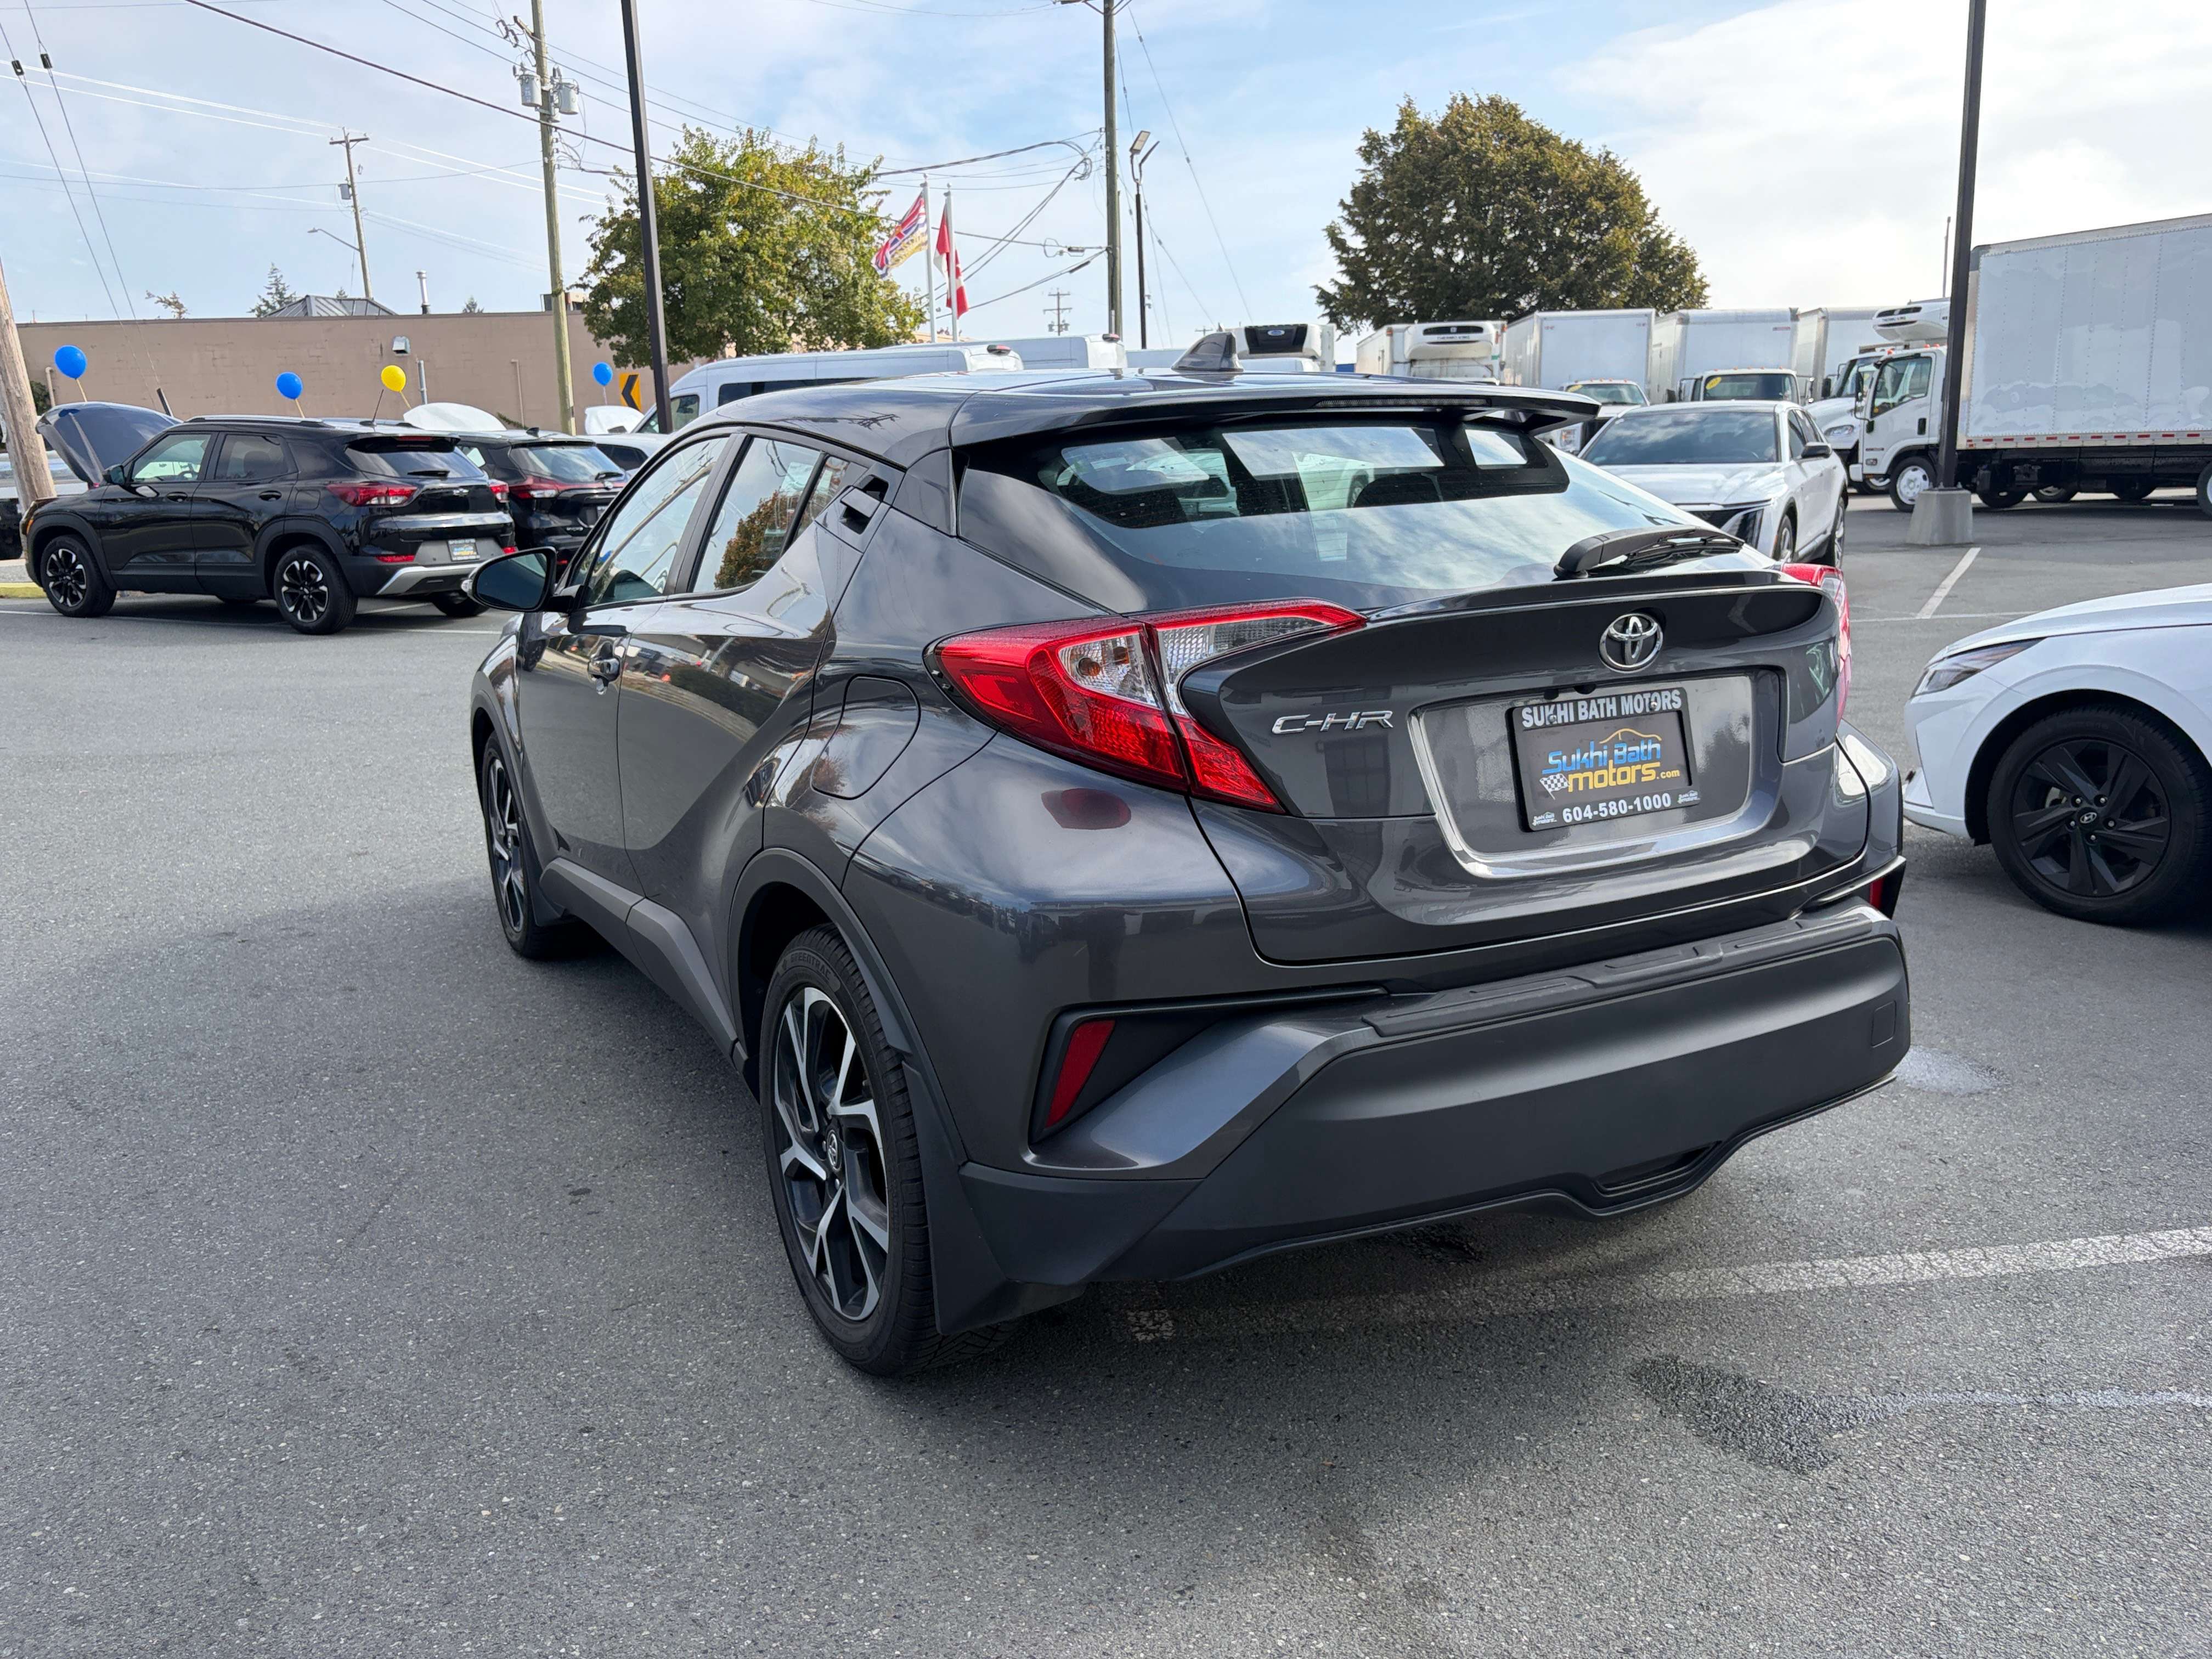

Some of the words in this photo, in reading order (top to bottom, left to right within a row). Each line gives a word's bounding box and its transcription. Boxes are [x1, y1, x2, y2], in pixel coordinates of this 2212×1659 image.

[1272, 710, 1394, 734] C-HR
[1522, 701, 1575, 728] SUKHI
[1578, 697, 1617, 720] BATH
[1621, 690, 1682, 716] MOTORS
[1542, 741, 1608, 775] Sukhi
[1613, 739, 1662, 765] Bath
[1562, 792, 1672, 823] 604-580-1000
